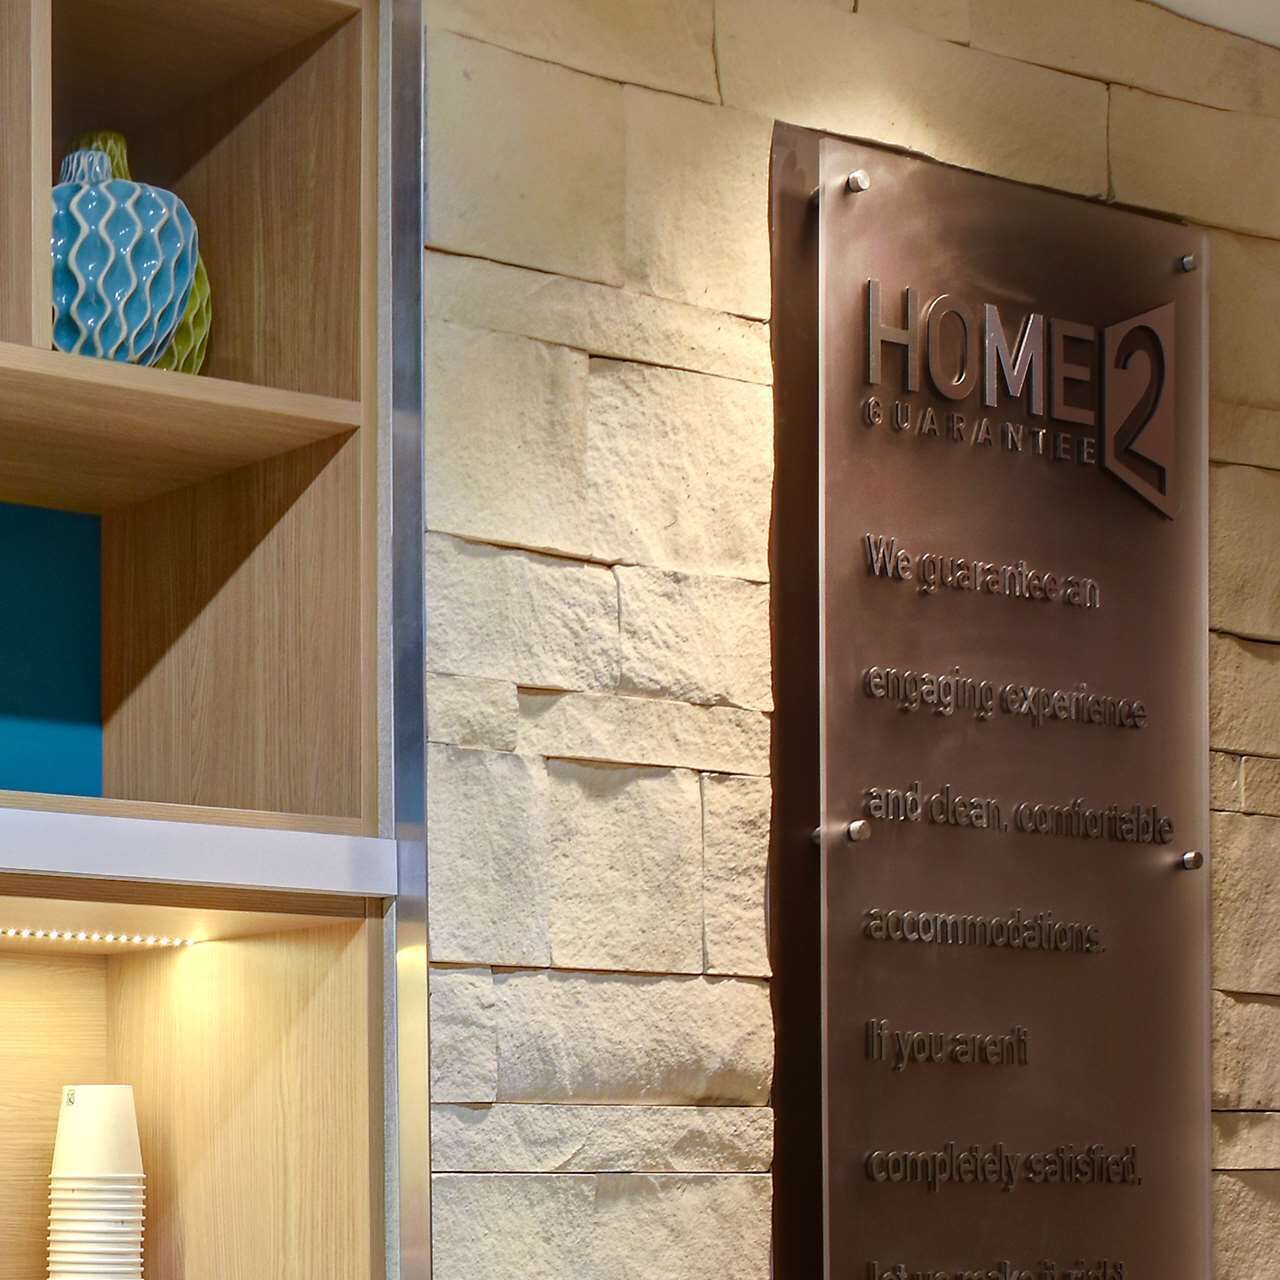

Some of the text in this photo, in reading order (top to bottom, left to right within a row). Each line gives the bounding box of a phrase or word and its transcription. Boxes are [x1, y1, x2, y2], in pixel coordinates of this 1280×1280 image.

[862, 396, 1097, 466] GUARANTEE
[865, 532, 1103, 608] We guarantee an
[864, 665, 1147, 728] engaging experience
[864, 780, 921, 823] and
[1012, 798, 1175, 844] comfortable
[865, 1017, 889, 1062] If
[891, 1030, 944, 1072] you
[864, 1140, 1022, 1193] completely
